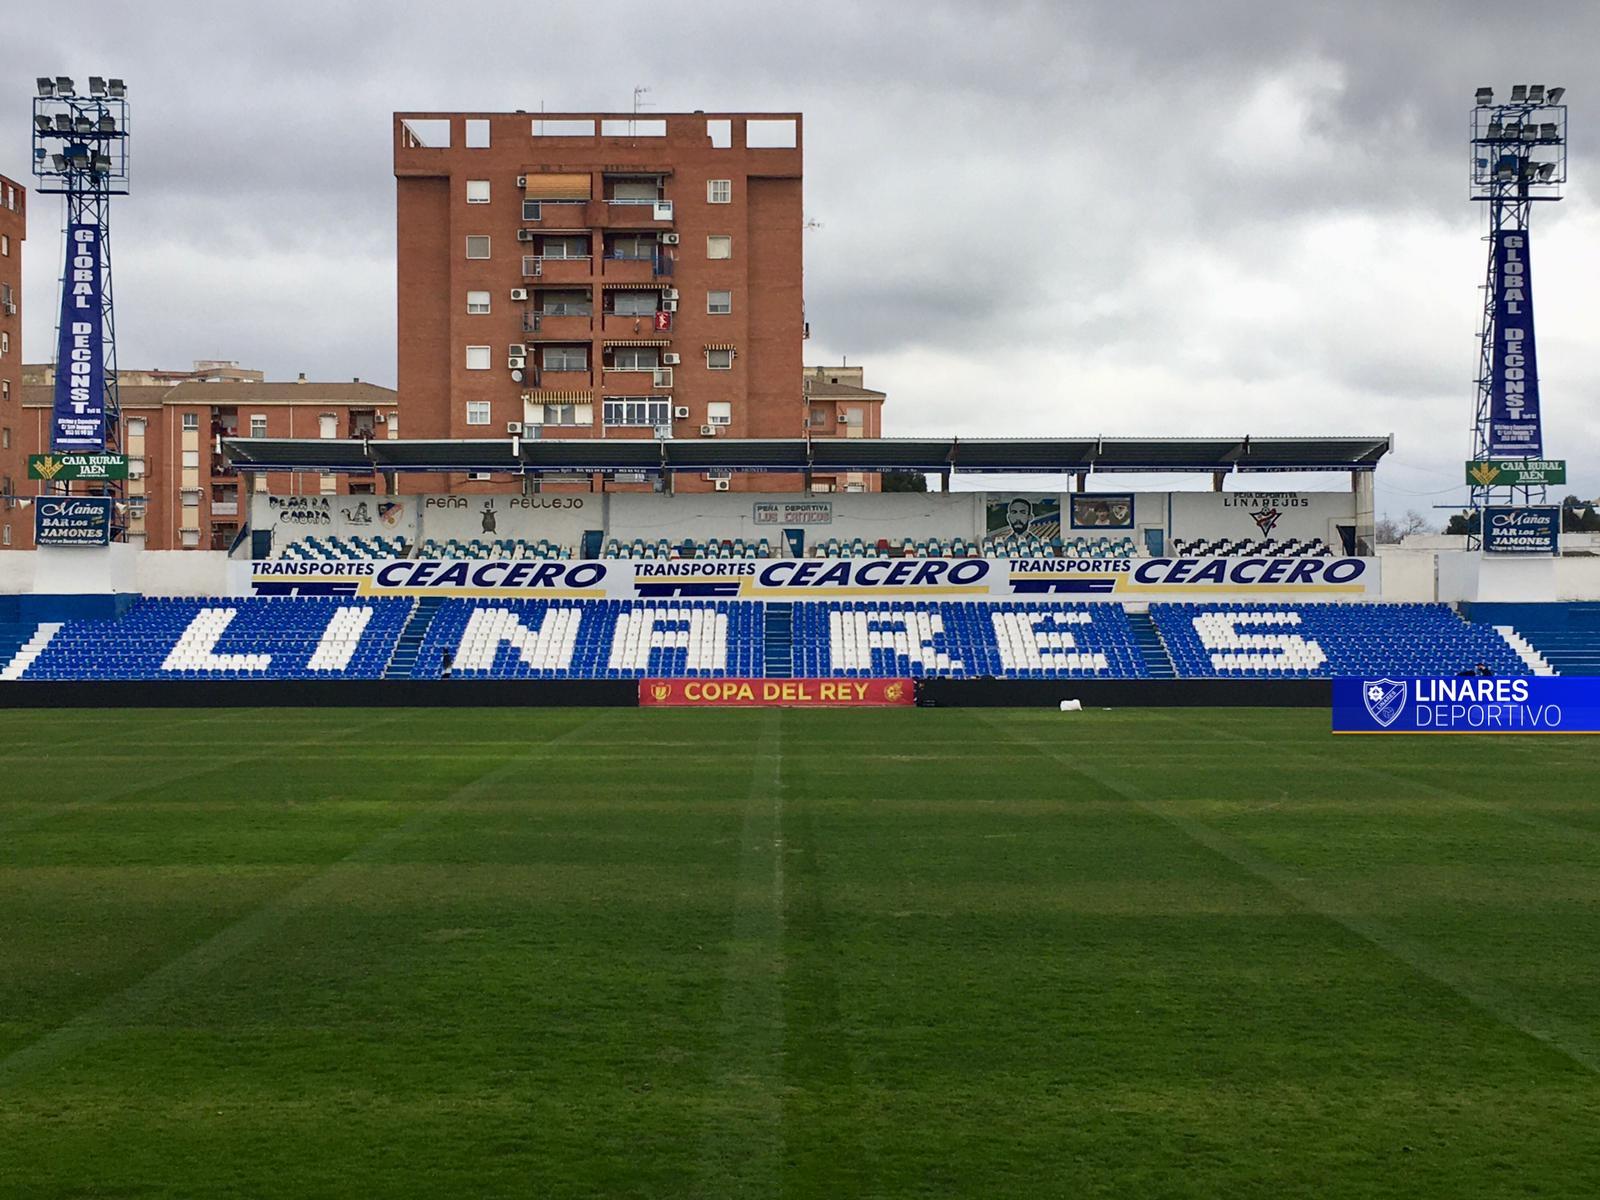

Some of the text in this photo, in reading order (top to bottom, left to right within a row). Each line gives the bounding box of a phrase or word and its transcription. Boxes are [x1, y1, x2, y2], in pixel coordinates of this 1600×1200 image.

[73, 229, 94, 308] GLOBAL
[1503, 236, 1524, 314] GLOBAL
[70, 322, 93, 414] DECONST
[1504, 328, 1525, 420] DECONST
[62, 456, 124, 465] CAJA RURAL
[1500, 462, 1563, 471] CAJA RURAL
[79, 465, 106, 475] JAÉN
[1518, 470, 1545, 480] JAÉN
[41, 502, 104, 516] Mañas
[425, 495, 468, 509] PEÑA
[510, 498, 584, 509] PELLEJO
[1223, 498, 1309, 508] LINAREJOS
[42, 518, 69, 527] BAR
[1491, 512, 1551, 526] Mañas
[41, 528, 103, 538] JAMONES
[1492, 528, 1517, 536] BAR
[1493, 537, 1551, 545] JAMONES
[252, 562, 608, 588] TRANSPORTES CEACERO
[634, 559, 990, 587] TRANSPORTES CEACERO
[1009, 558, 1367, 584] TRANSPORTES CEACERO
[683, 682, 870, 701] COPA DEL REY
